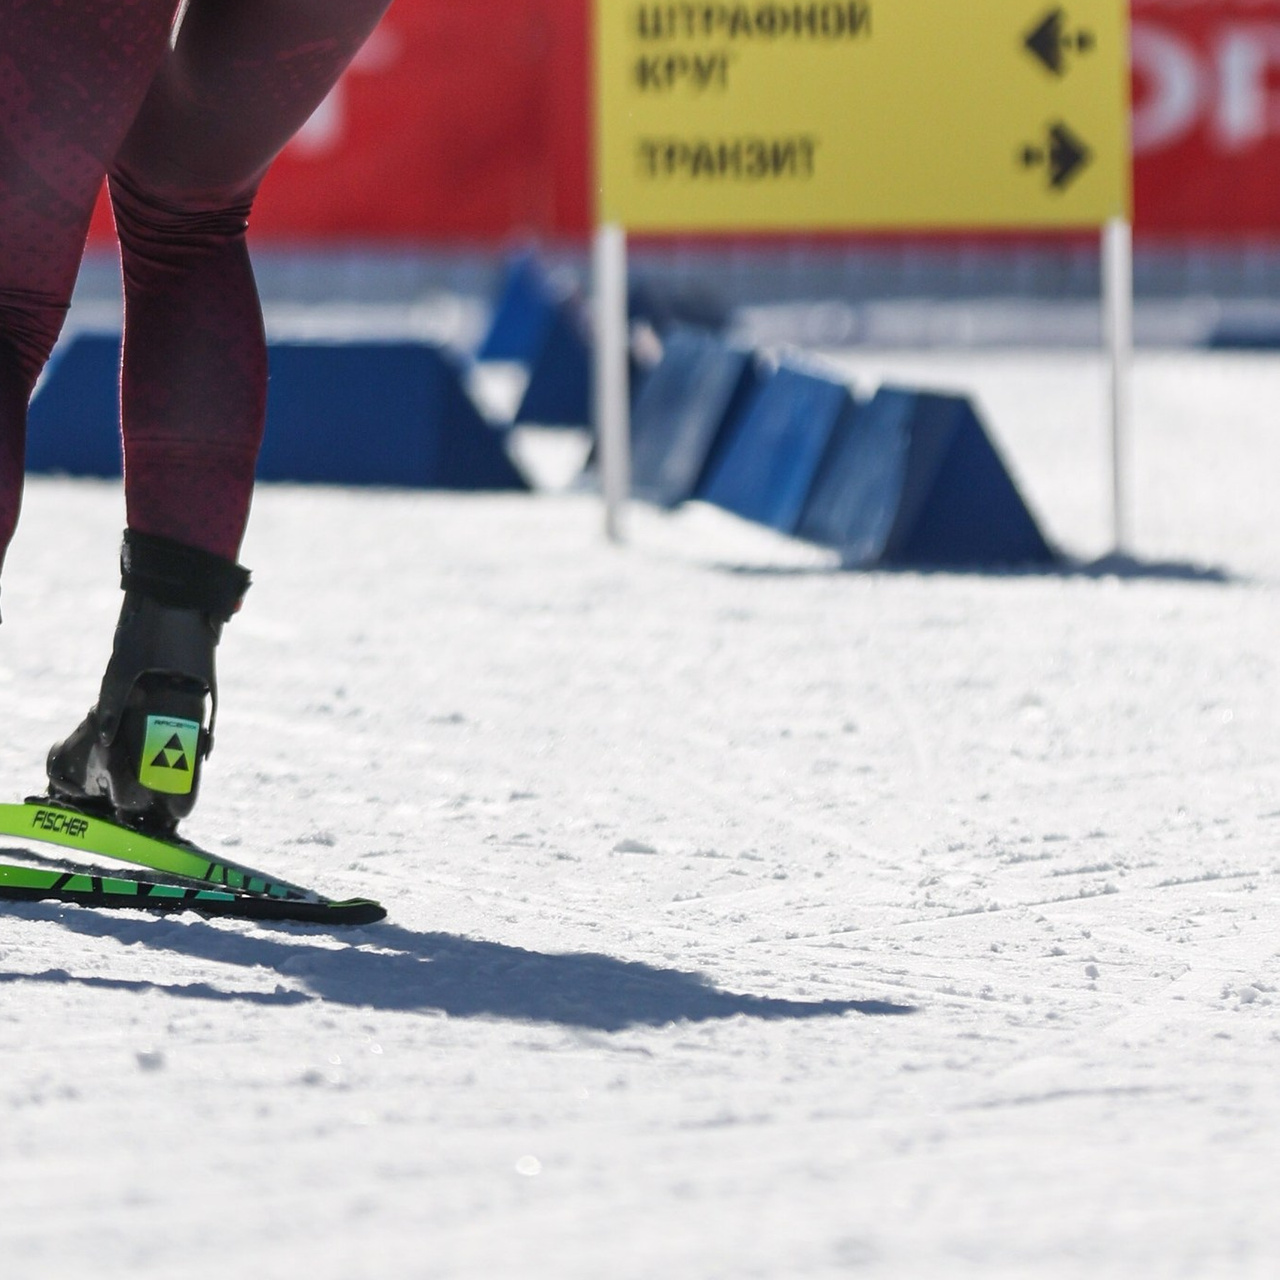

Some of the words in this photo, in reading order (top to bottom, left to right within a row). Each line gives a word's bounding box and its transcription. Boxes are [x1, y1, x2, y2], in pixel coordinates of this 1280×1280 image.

[634, 52, 734, 92] КРУГ
[637, 133, 816, 179] ТРАНЗИТ
[31, 810, 89, 839] FISCHER
